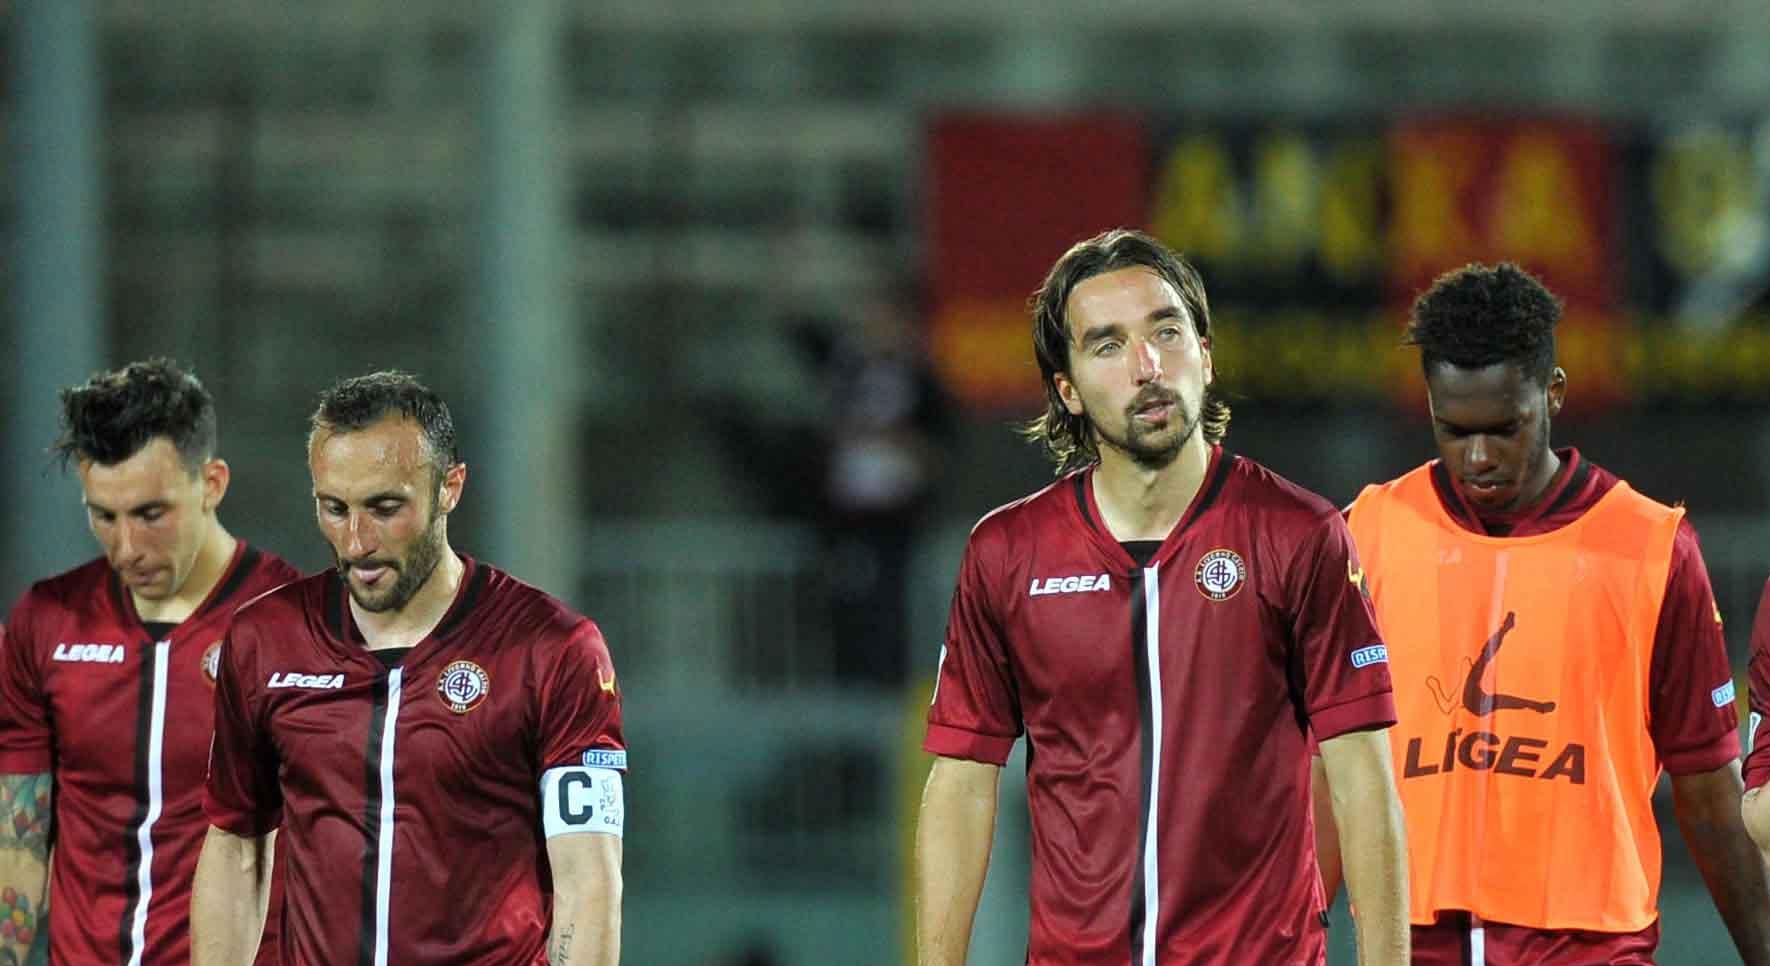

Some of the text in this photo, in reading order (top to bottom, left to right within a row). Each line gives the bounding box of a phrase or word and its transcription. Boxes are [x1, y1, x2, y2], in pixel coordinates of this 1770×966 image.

[1030, 574, 1111, 596] LEGEA
[53, 643, 125, 663] LEGEA
[267, 672, 345, 689] LEGEA
[558, 771, 593, 826] C
